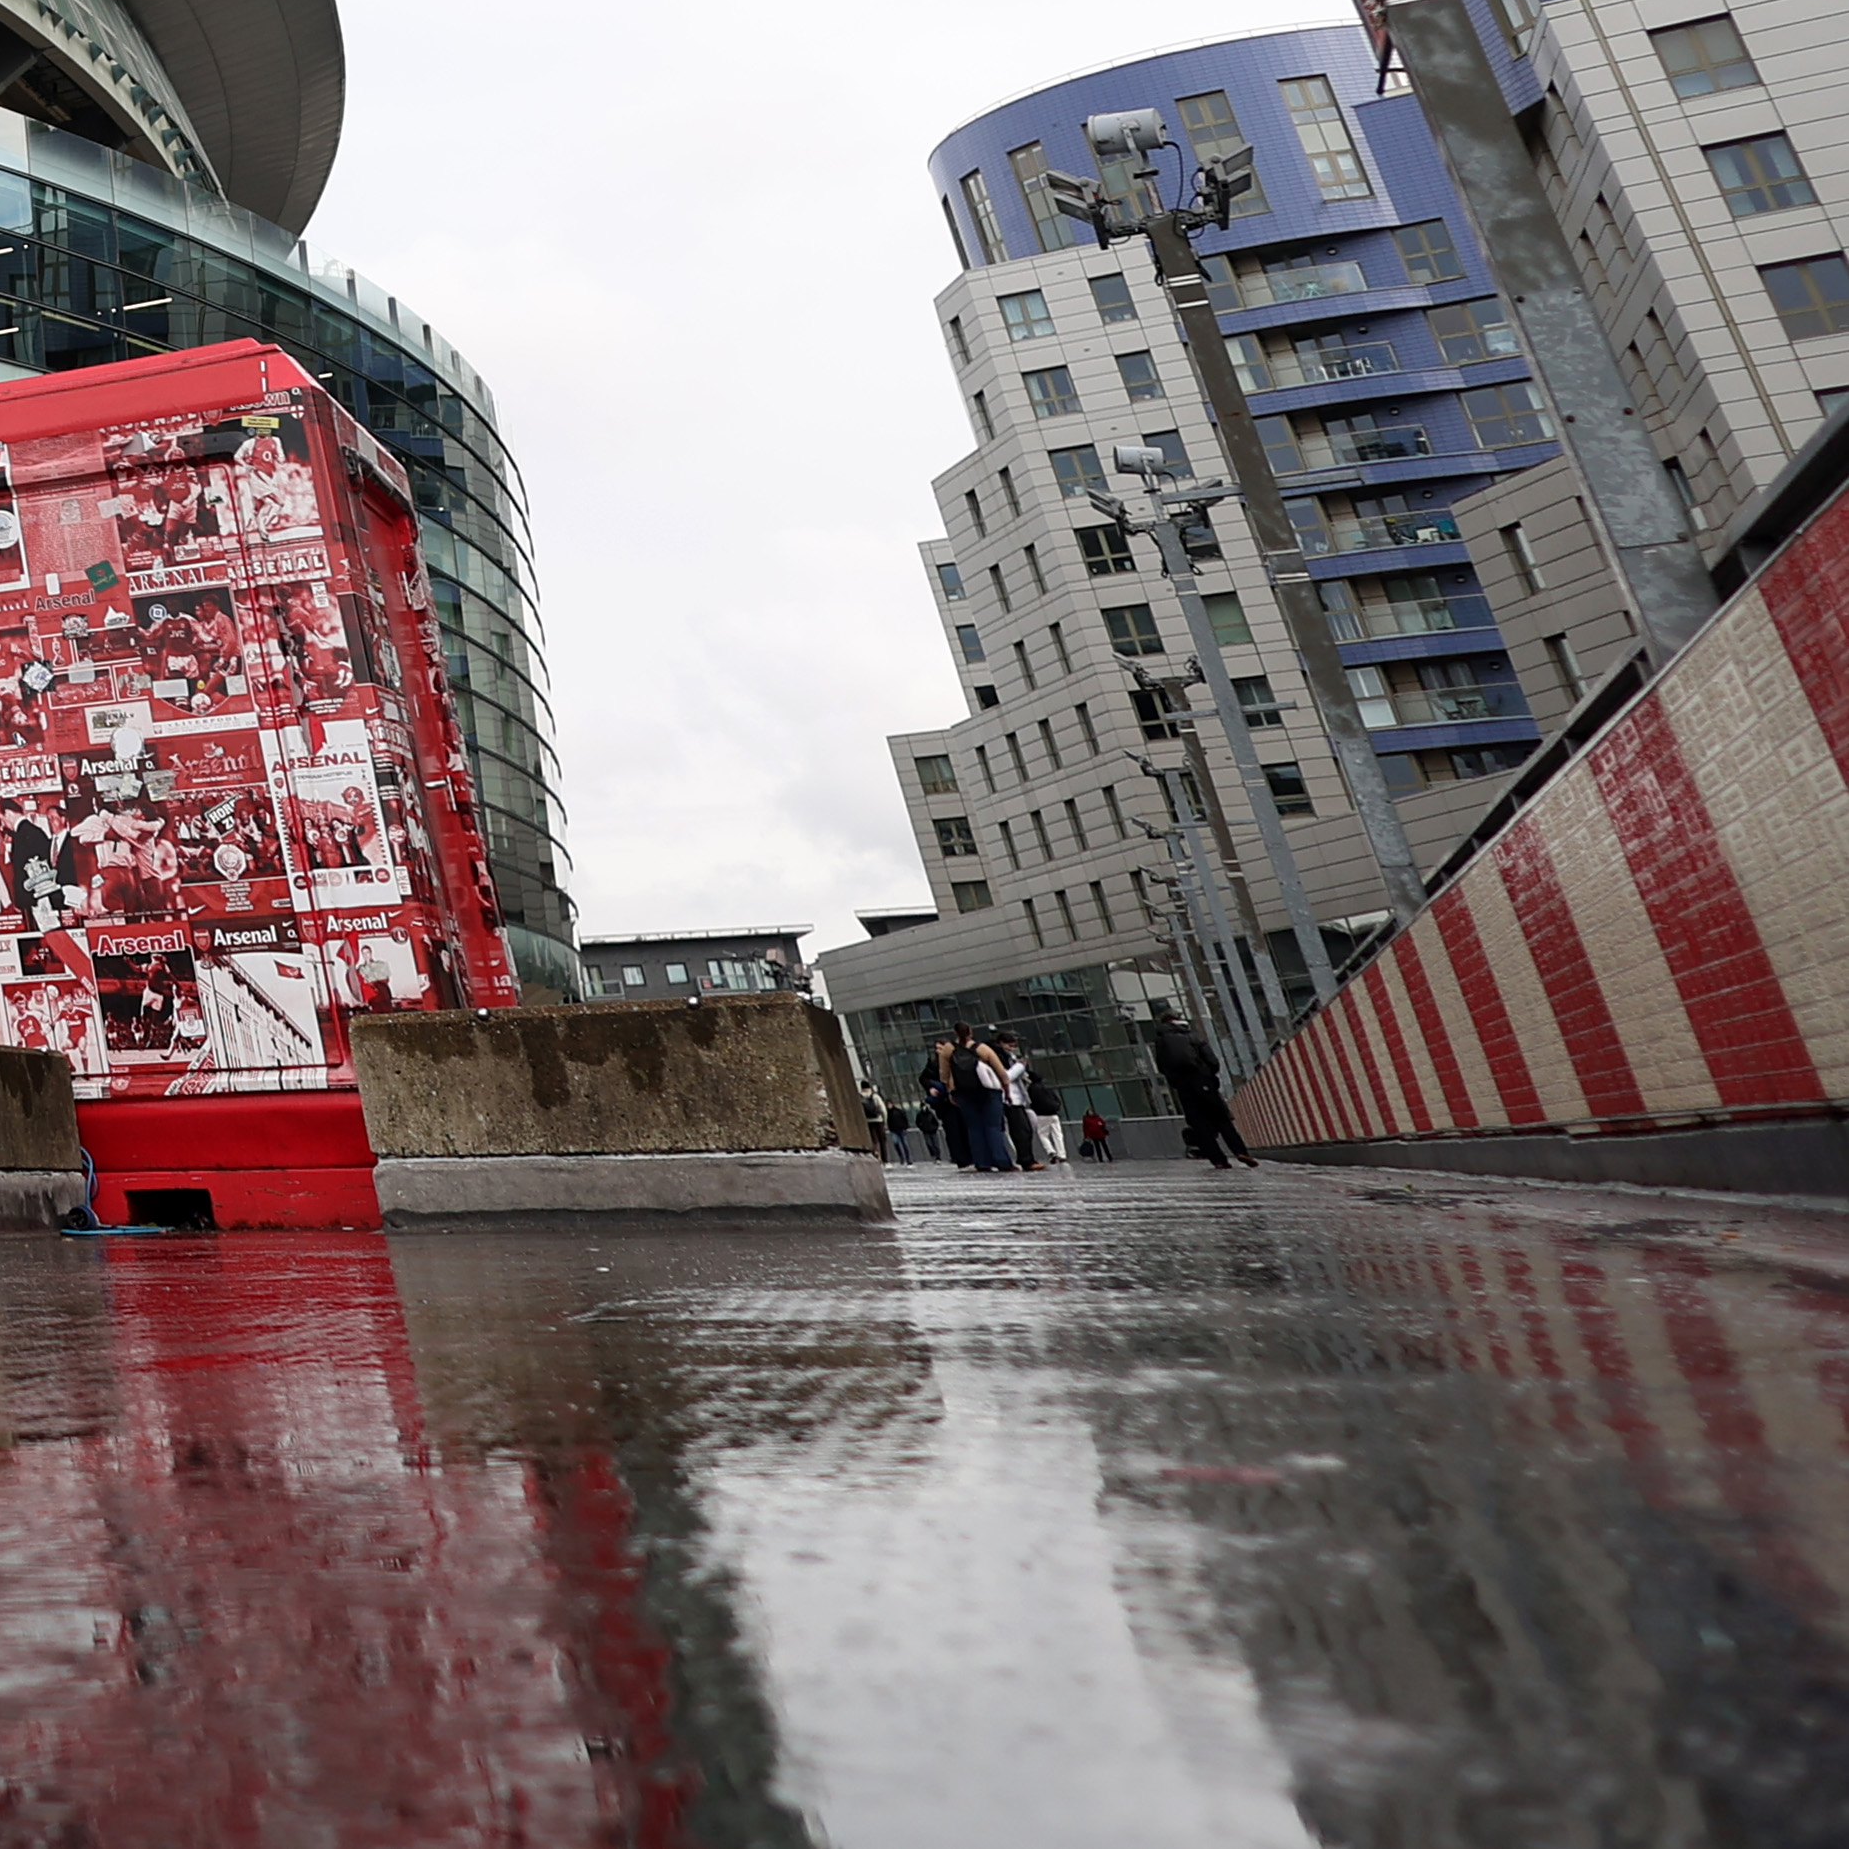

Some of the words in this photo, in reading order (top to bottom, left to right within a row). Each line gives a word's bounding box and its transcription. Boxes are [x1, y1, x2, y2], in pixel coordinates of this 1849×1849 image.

[80, 758, 138, 777] Arsenal
[272, 752, 367, 771] ARSENAL
[326, 914, 387, 932] Arsenal
[97, 931, 186, 956] Arsenal
[214, 926, 277, 947] Arsenal
